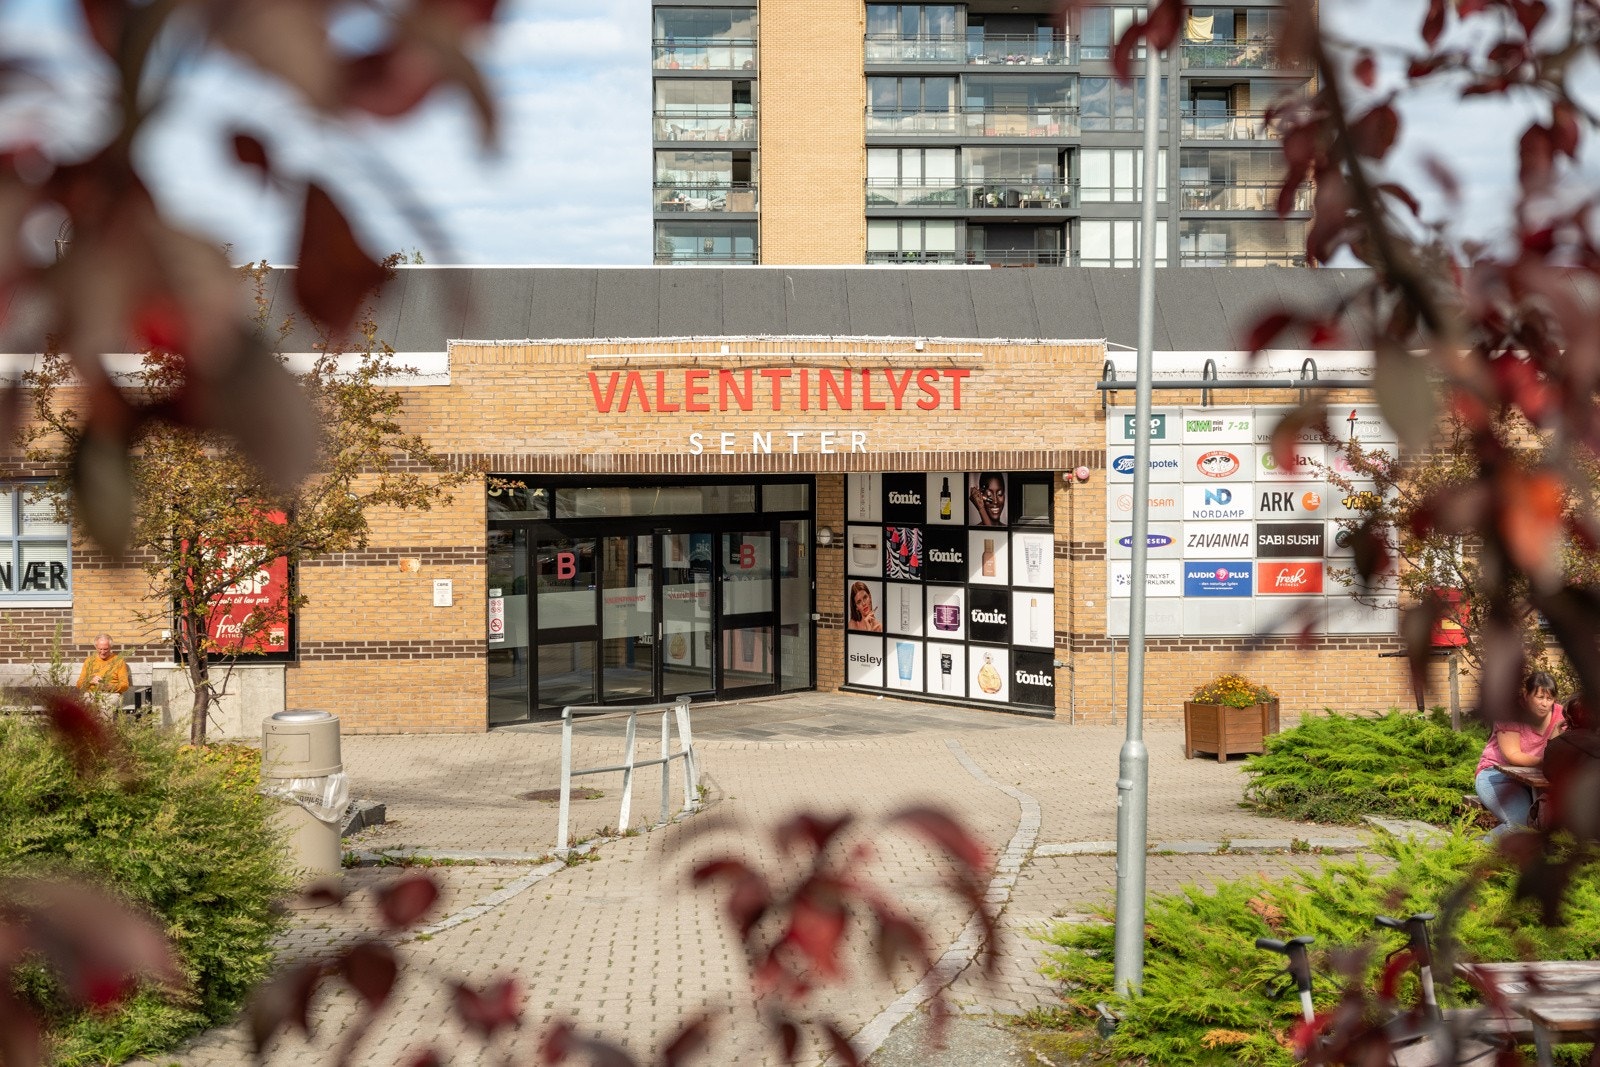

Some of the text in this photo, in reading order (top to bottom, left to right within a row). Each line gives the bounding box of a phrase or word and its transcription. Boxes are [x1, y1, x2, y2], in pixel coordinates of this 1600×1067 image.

[588, 369, 970, 413] VALENTINLYST
[1186, 420, 1211, 432] KIWI
[1228, 421, 1249, 430] 7-23
[689, 431, 868, 455] SENTER
[1205, 488, 1232, 506] ND
[1260, 491, 1294, 511] ARK
[1193, 510, 1245, 518] NORDAMP
[1187, 533, 1249, 548] ZAVANNA
[1259, 534, 1319, 545] SABI SUSHI
[739, 544, 756, 569] B
[557, 552, 576, 580] B
[1187, 571, 1250, 579] AUDIO PLUS
[1275, 568, 1307, 587] fresh
[850, 653, 883, 667] sisley
